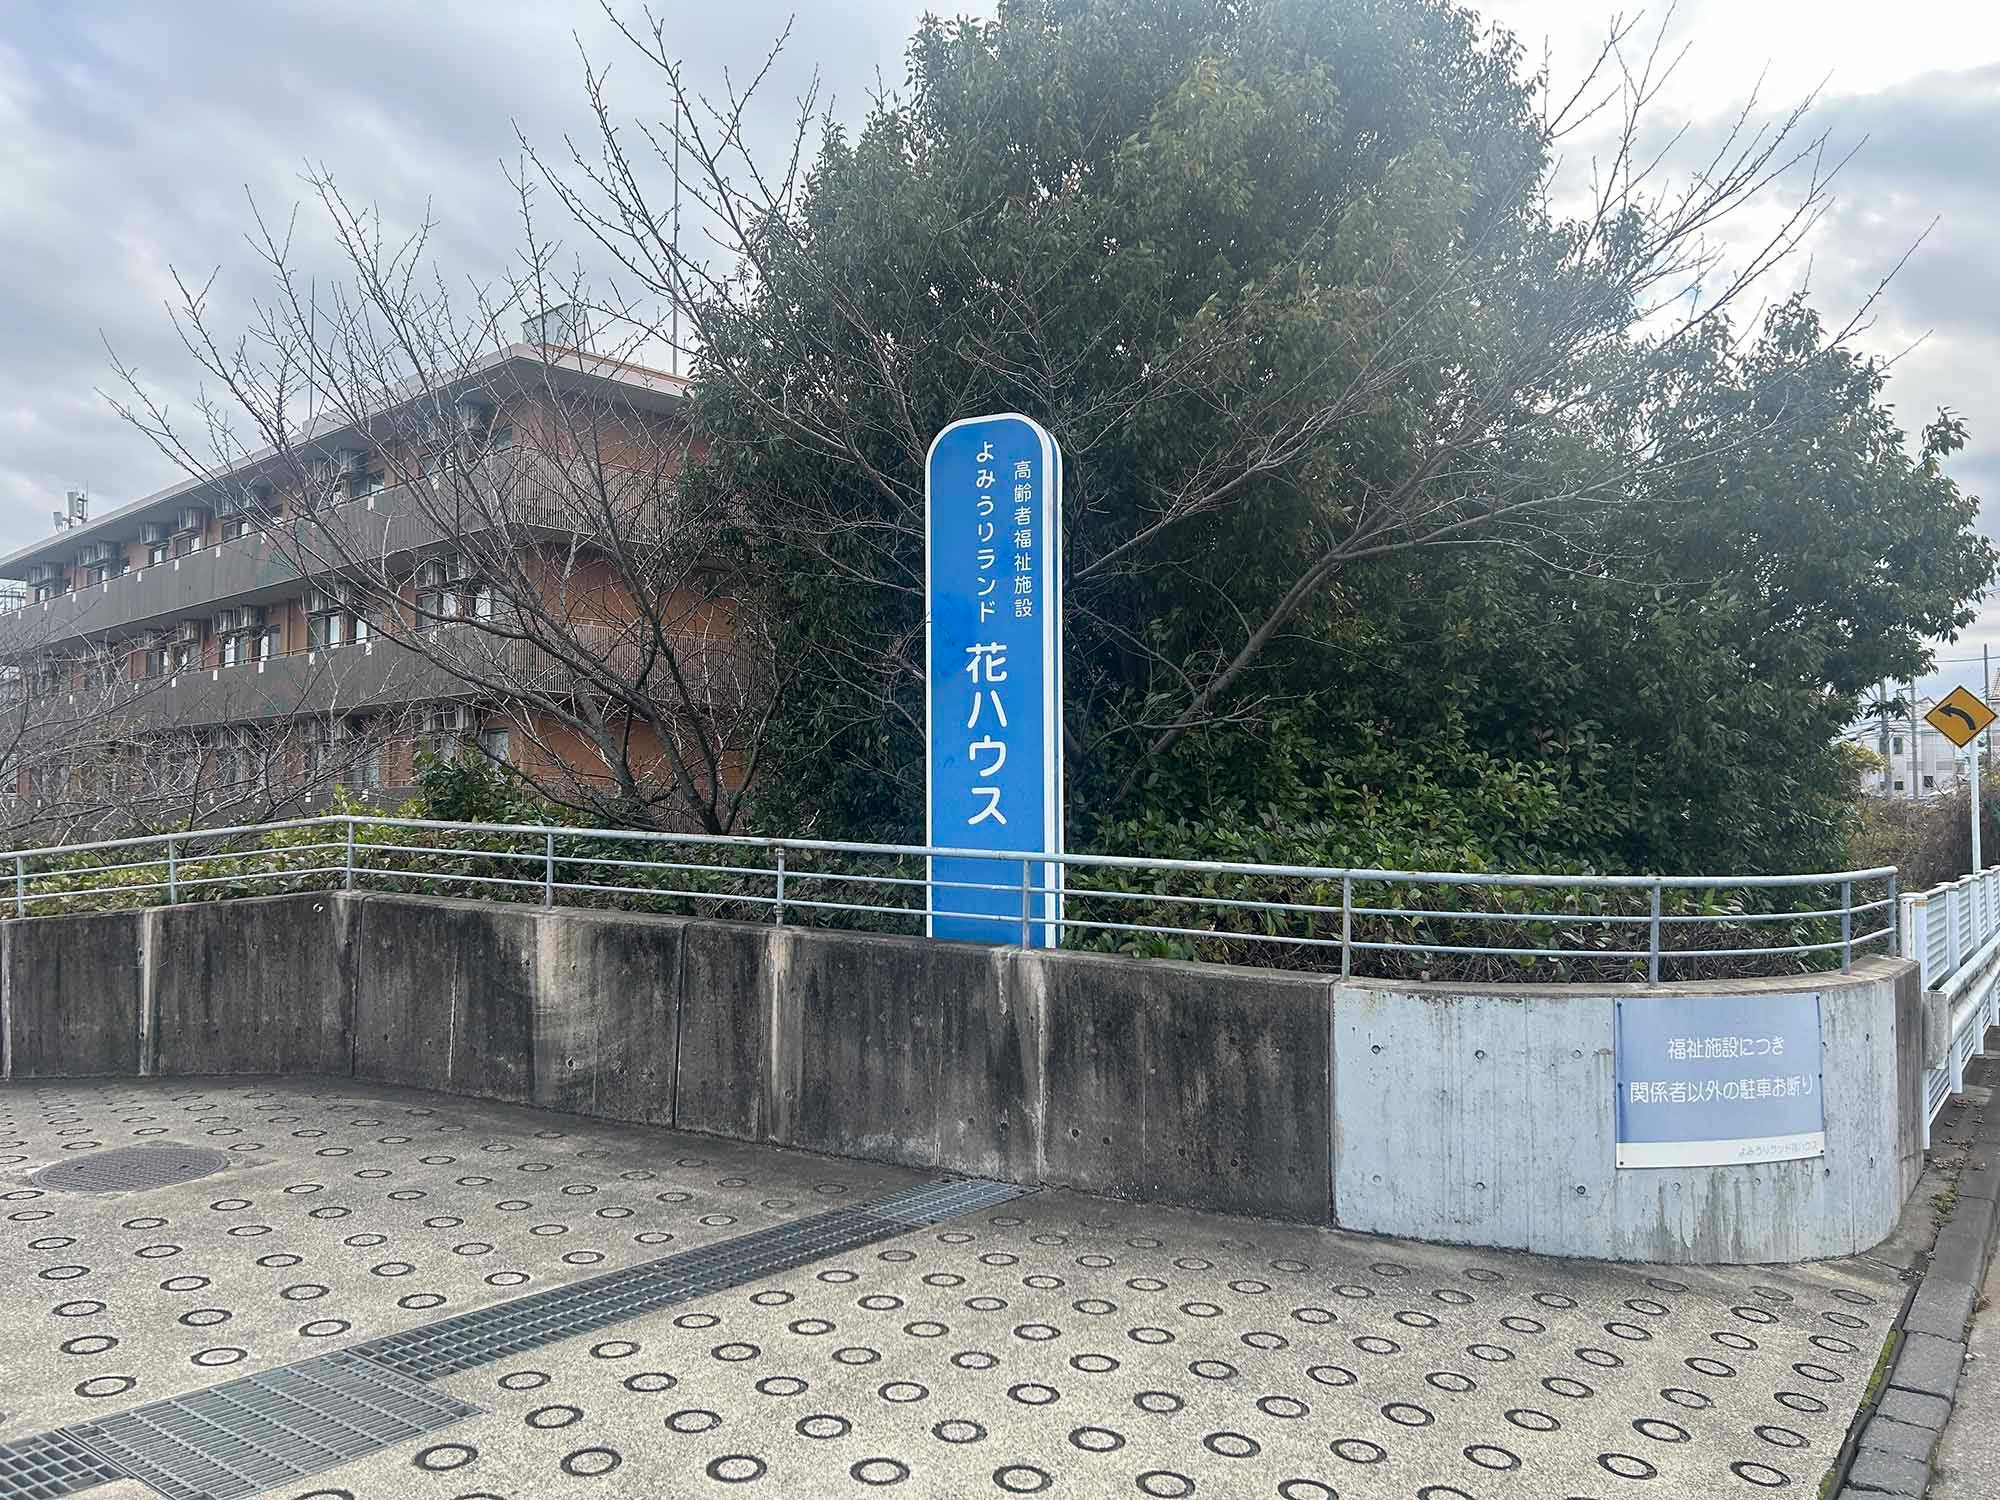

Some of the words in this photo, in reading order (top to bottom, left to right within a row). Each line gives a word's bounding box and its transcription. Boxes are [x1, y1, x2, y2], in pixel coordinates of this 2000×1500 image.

[975, 441, 996, 623] よみうりランド
[1014, 460, 1033, 618] 高齢者福祉施設
[966, 642, 1008, 825] 花ハウス
[1630, 1073, 1814, 1104] 関係者以外の駐車お断り
[1667, 1036, 1785, 1060] 福祉施設につき
